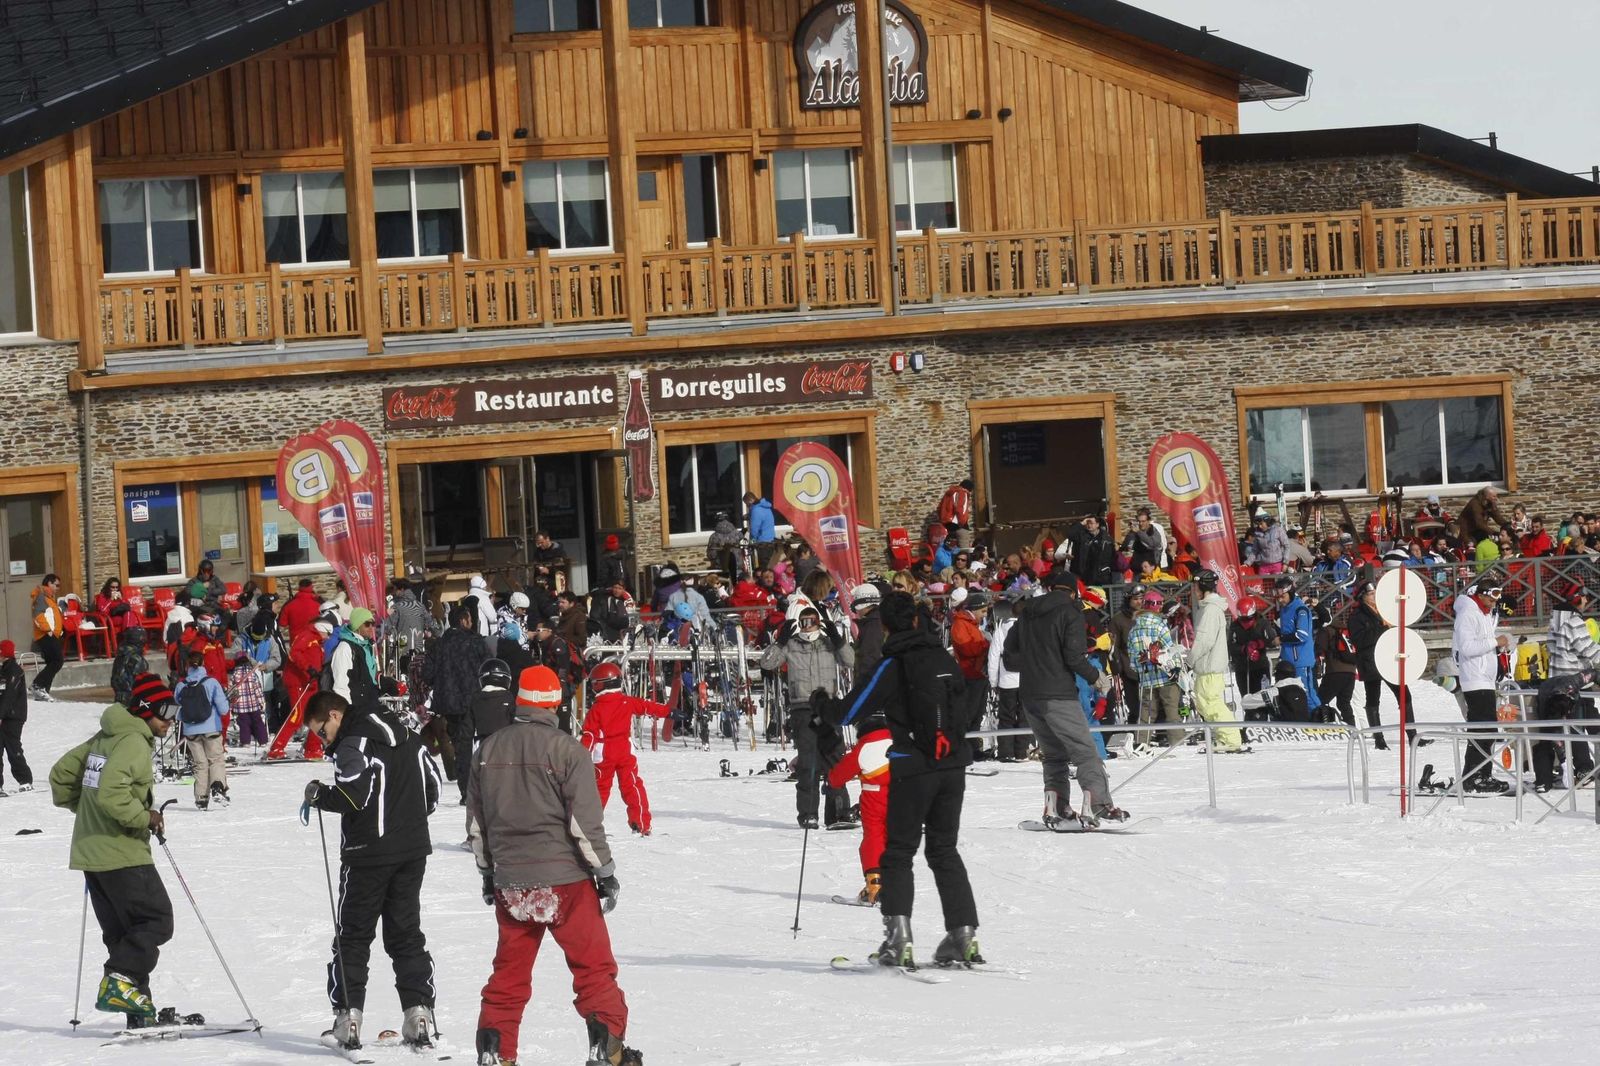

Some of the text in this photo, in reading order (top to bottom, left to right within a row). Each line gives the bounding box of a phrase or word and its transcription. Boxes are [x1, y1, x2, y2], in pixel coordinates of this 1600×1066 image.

[806, 59, 925, 105] Alcaba
[474, 384, 614, 412] Restaurante
[123, 489, 160, 499] onsigna
